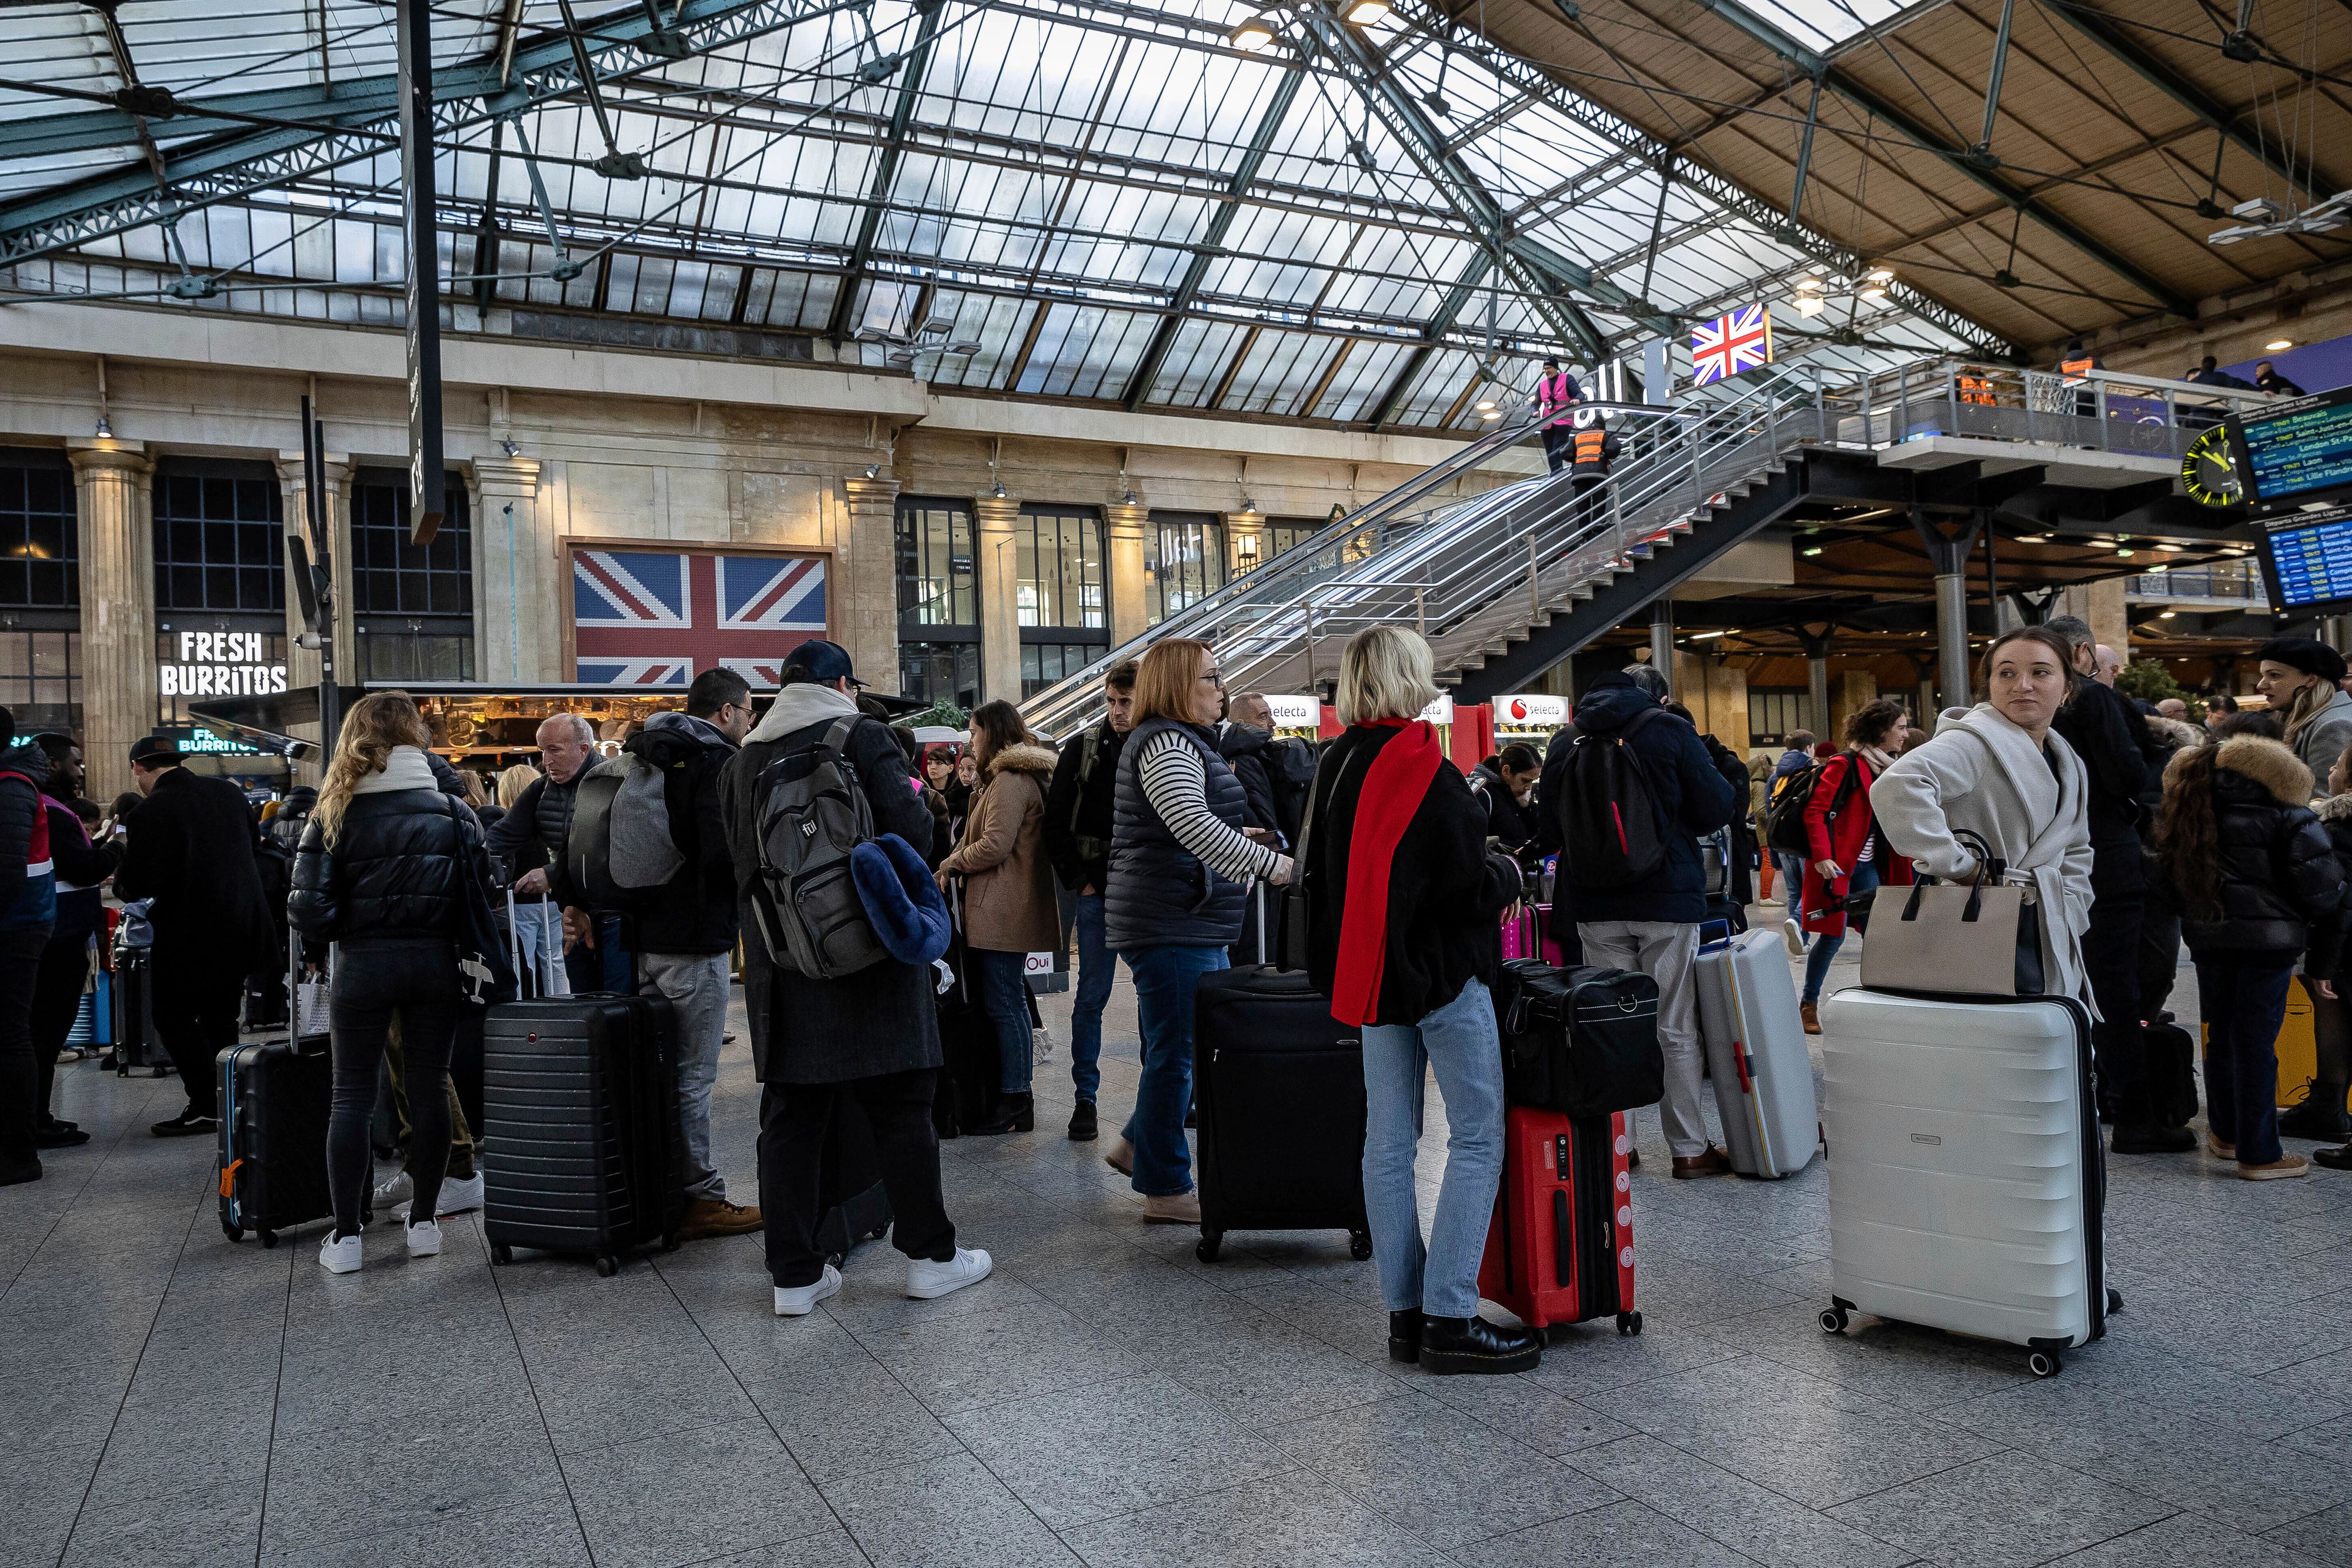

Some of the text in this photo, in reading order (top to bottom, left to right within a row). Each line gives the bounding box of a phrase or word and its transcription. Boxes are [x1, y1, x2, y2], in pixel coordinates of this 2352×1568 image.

[2299, 439, 2329, 453] London
[181, 632, 262, 662] FRESH
[1531, 704, 1559, 715] selecta
